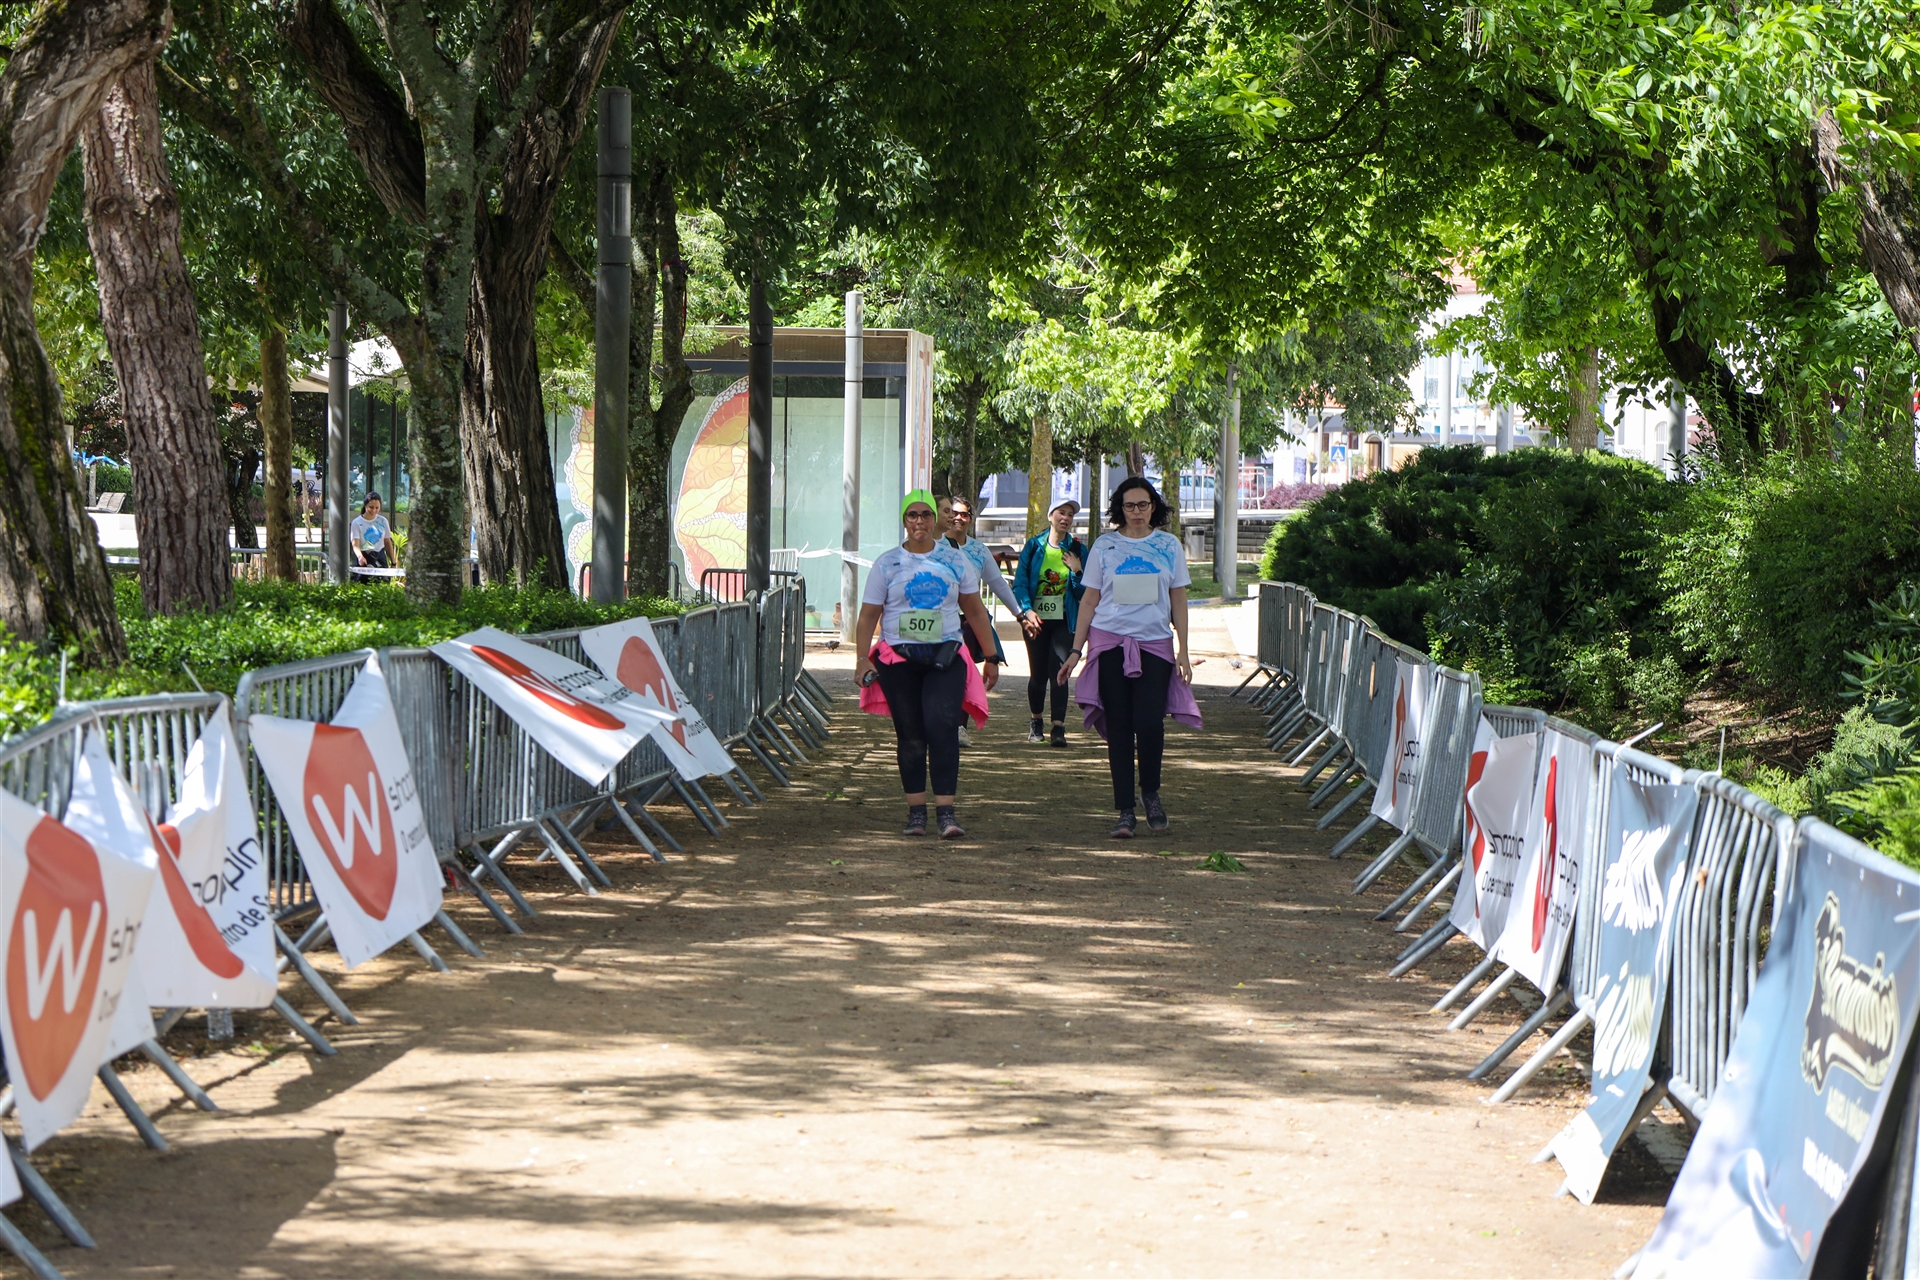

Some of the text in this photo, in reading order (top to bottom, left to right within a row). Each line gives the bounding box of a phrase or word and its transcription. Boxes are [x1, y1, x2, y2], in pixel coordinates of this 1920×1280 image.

[1038, 602, 1057, 612] 469
[909, 618, 935, 632] 507
[312, 770, 382, 870] W
[237, 907, 266, 928] de
[23, 900, 102, 1021] W
